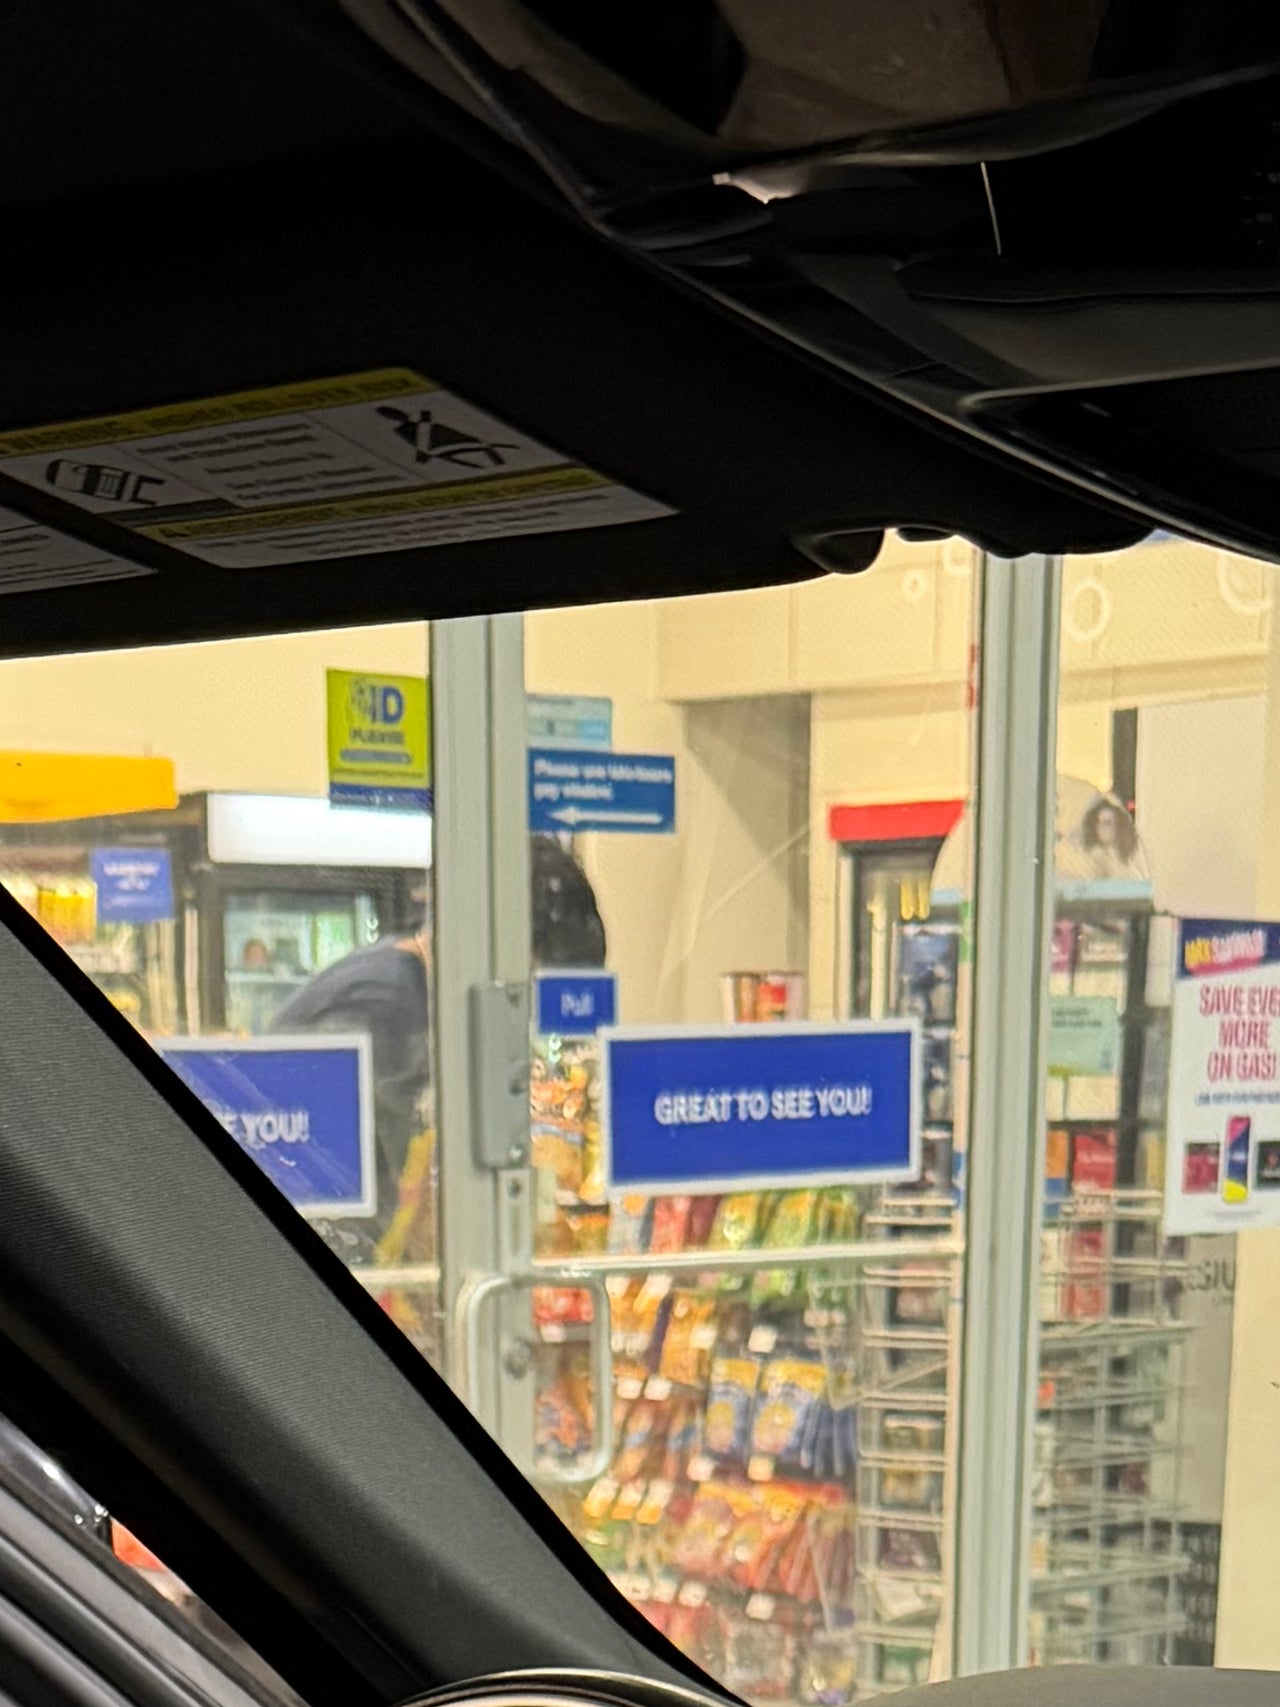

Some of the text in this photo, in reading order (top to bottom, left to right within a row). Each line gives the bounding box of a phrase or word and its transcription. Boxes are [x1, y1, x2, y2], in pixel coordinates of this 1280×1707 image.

[1199, 983, 1244, 1017] SAVE
[1219, 1018, 1270, 1049] MORE
[1207, 1050, 1232, 1083] ON
[653, 1085, 872, 1126] GREAT TO SEE YOU!
